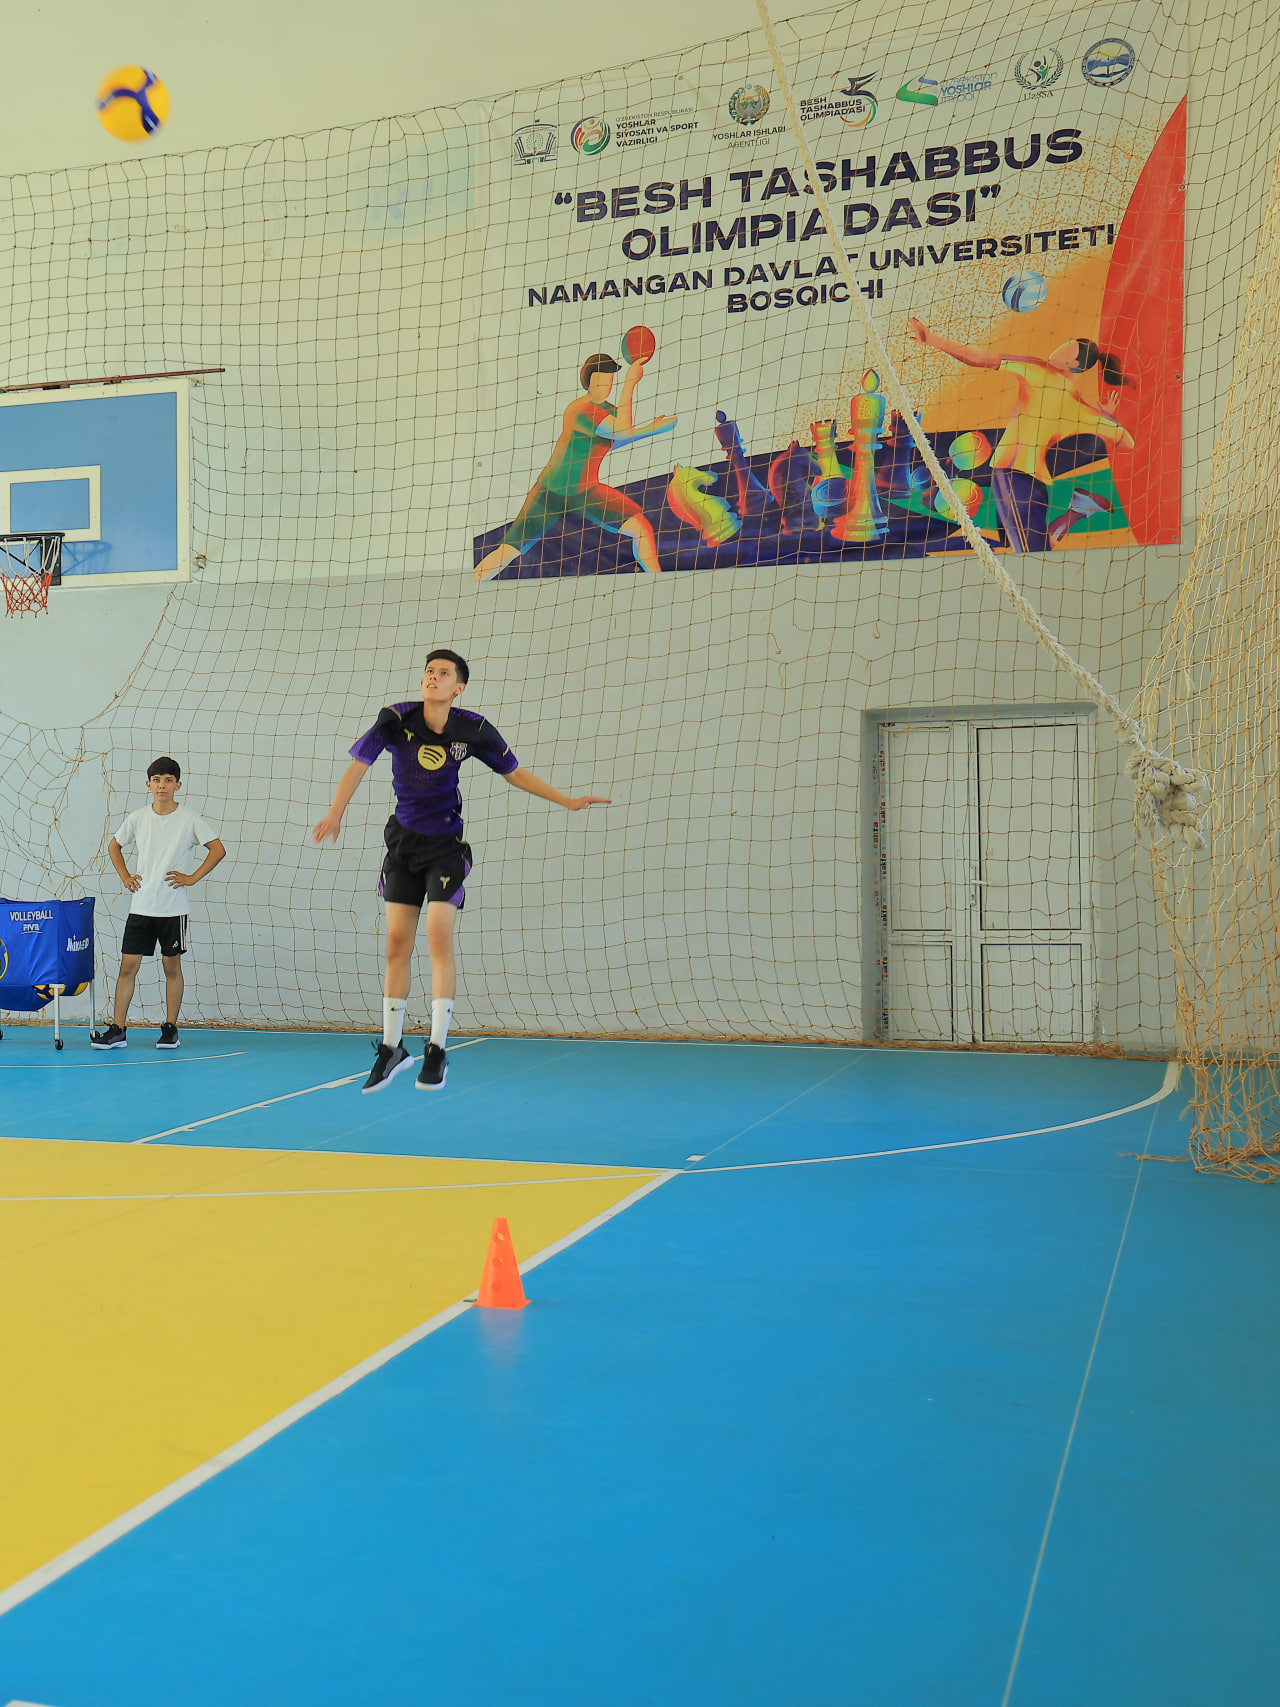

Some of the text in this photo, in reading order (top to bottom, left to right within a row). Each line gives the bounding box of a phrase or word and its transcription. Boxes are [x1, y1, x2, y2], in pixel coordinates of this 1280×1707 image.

[800, 97, 827, 107] BESH
[800, 99, 862, 114] TASHABBUS
[800, 106, 866, 121] OLIMPIADASI
[616, 119, 656, 129] YOSHLAR
[616, 121, 699, 139] SIYOSATI VA SPORT
[713, 126, 786, 141] YOSHLAR ISHLARI
[616, 137, 658, 148] VAZIRLIGI
[728, 138, 770, 149] AGENTLIGI
[729, 128, 1083, 202] TASHABBUS
[528, 269, 713, 308] NAMANGAN
[869, 223, 1115, 271] UNIVERSITETI
[727, 278, 884, 314] BOSQICHI
[9, 910, 54, 921] VOLLEYBALL
